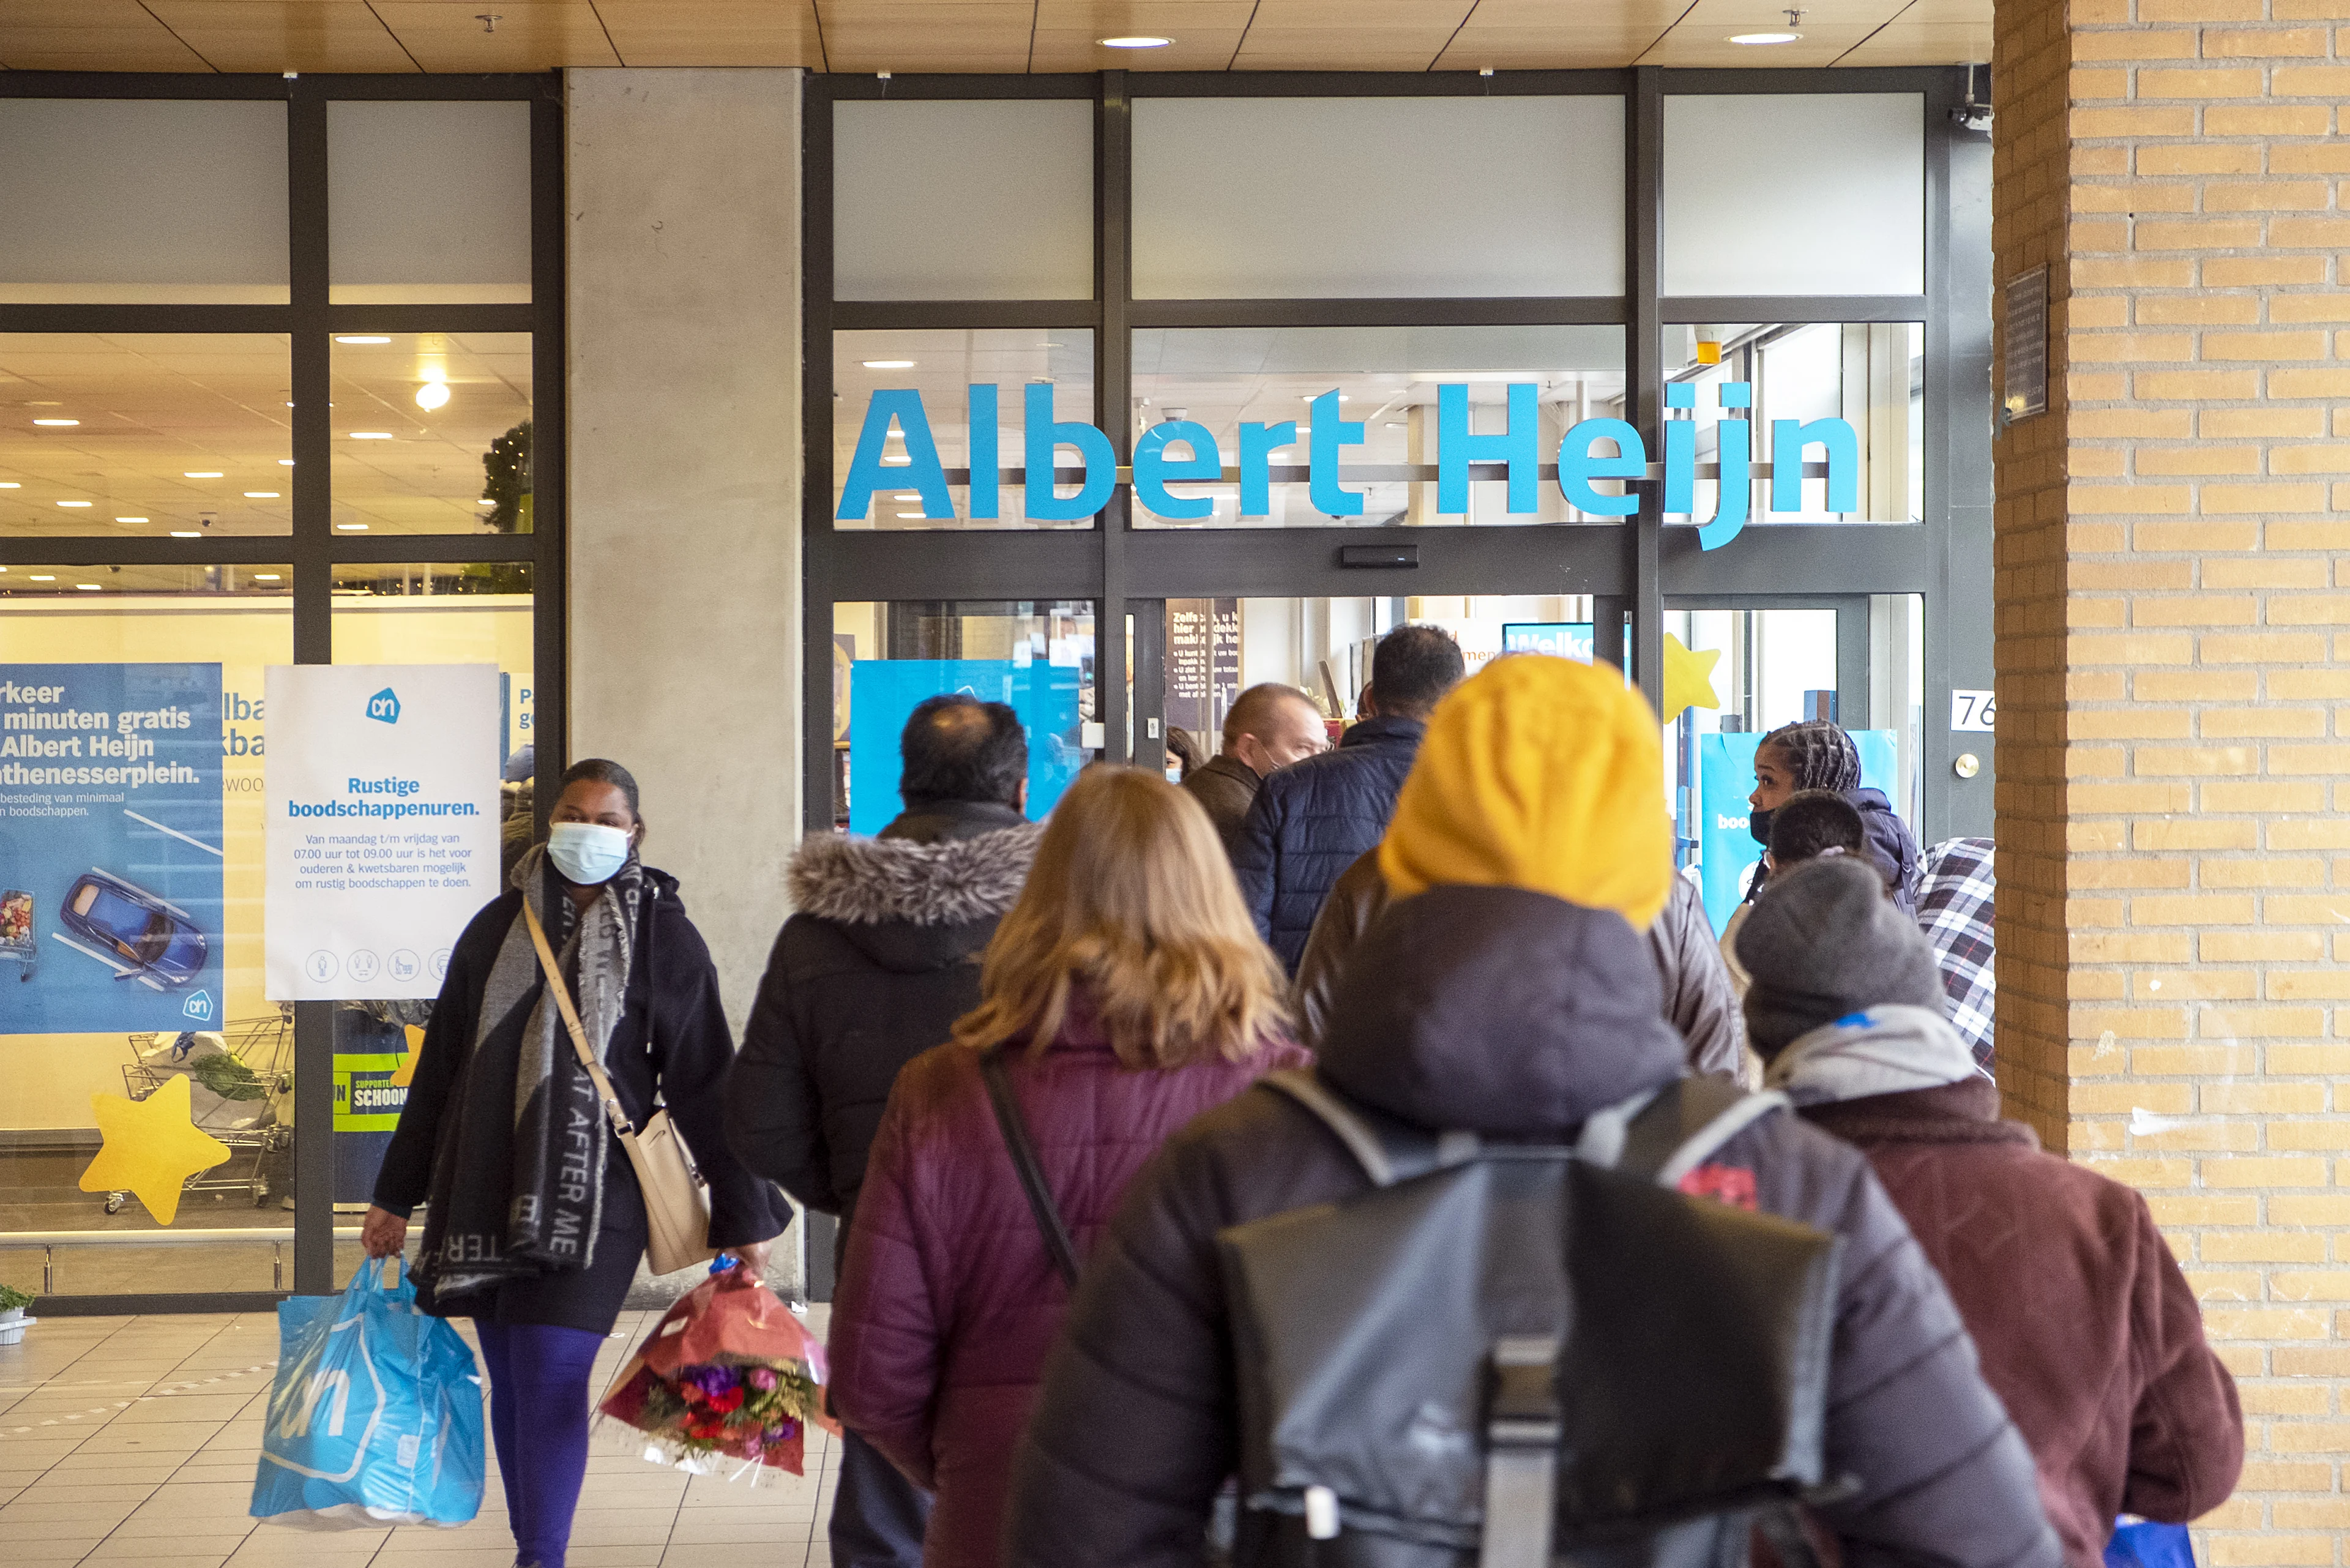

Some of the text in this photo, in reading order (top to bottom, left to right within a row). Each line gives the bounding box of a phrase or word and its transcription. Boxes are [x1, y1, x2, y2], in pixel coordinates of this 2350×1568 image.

[835, 381, 1859, 551] Albert Heijn
[4, 706, 192, 734] minuten gratis
[1958, 695, 1996, 726] 76
[1, 733, 154, 762] Albert Heijn
[0, 761, 200, 788] thenesserplein.
[223, 777, 264, 792] woo
[348, 776, 420, 797] Rustige
[1, 793, 125, 805] besteding van minimaal
[9, 805, 89, 818] boodschappen.
[288, 799, 480, 819] boodschappenuren.
[1717, 813, 1750, 829] boo
[305, 833, 460, 846] Van maandag t/m vrijdag van
[294, 849, 321, 859] 07.00
[346, 849, 360, 859] tot
[363, 848, 393, 859] 09.00
[417, 848, 425, 858] is
[429, 848, 446, 857] het
[449, 849, 472, 857] voor
[299, 862, 466, 875] ouderen & kwetsbaren mogelijk
[295, 877, 471, 890] om rustig boodschappen te doen.
[354, 1088, 409, 1107] SCHOON
[558, 1107, 591, 1203] AFTER
[549, 1208, 582, 1255] ME
